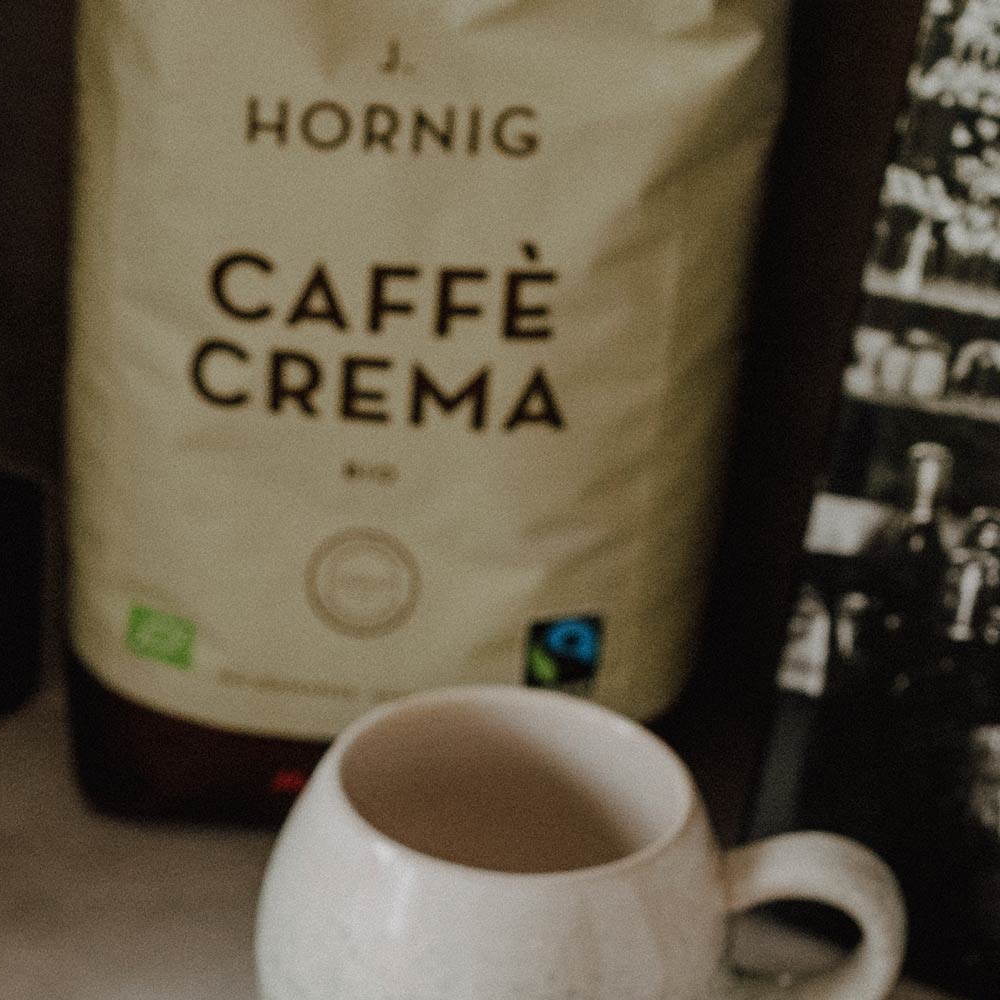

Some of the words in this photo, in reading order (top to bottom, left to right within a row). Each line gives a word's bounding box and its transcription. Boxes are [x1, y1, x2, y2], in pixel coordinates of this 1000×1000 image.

[244, 98, 540, 158] HORNIG
[206, 241, 559, 342] CAFFÈ
[188, 335, 567, 433] CREMA
